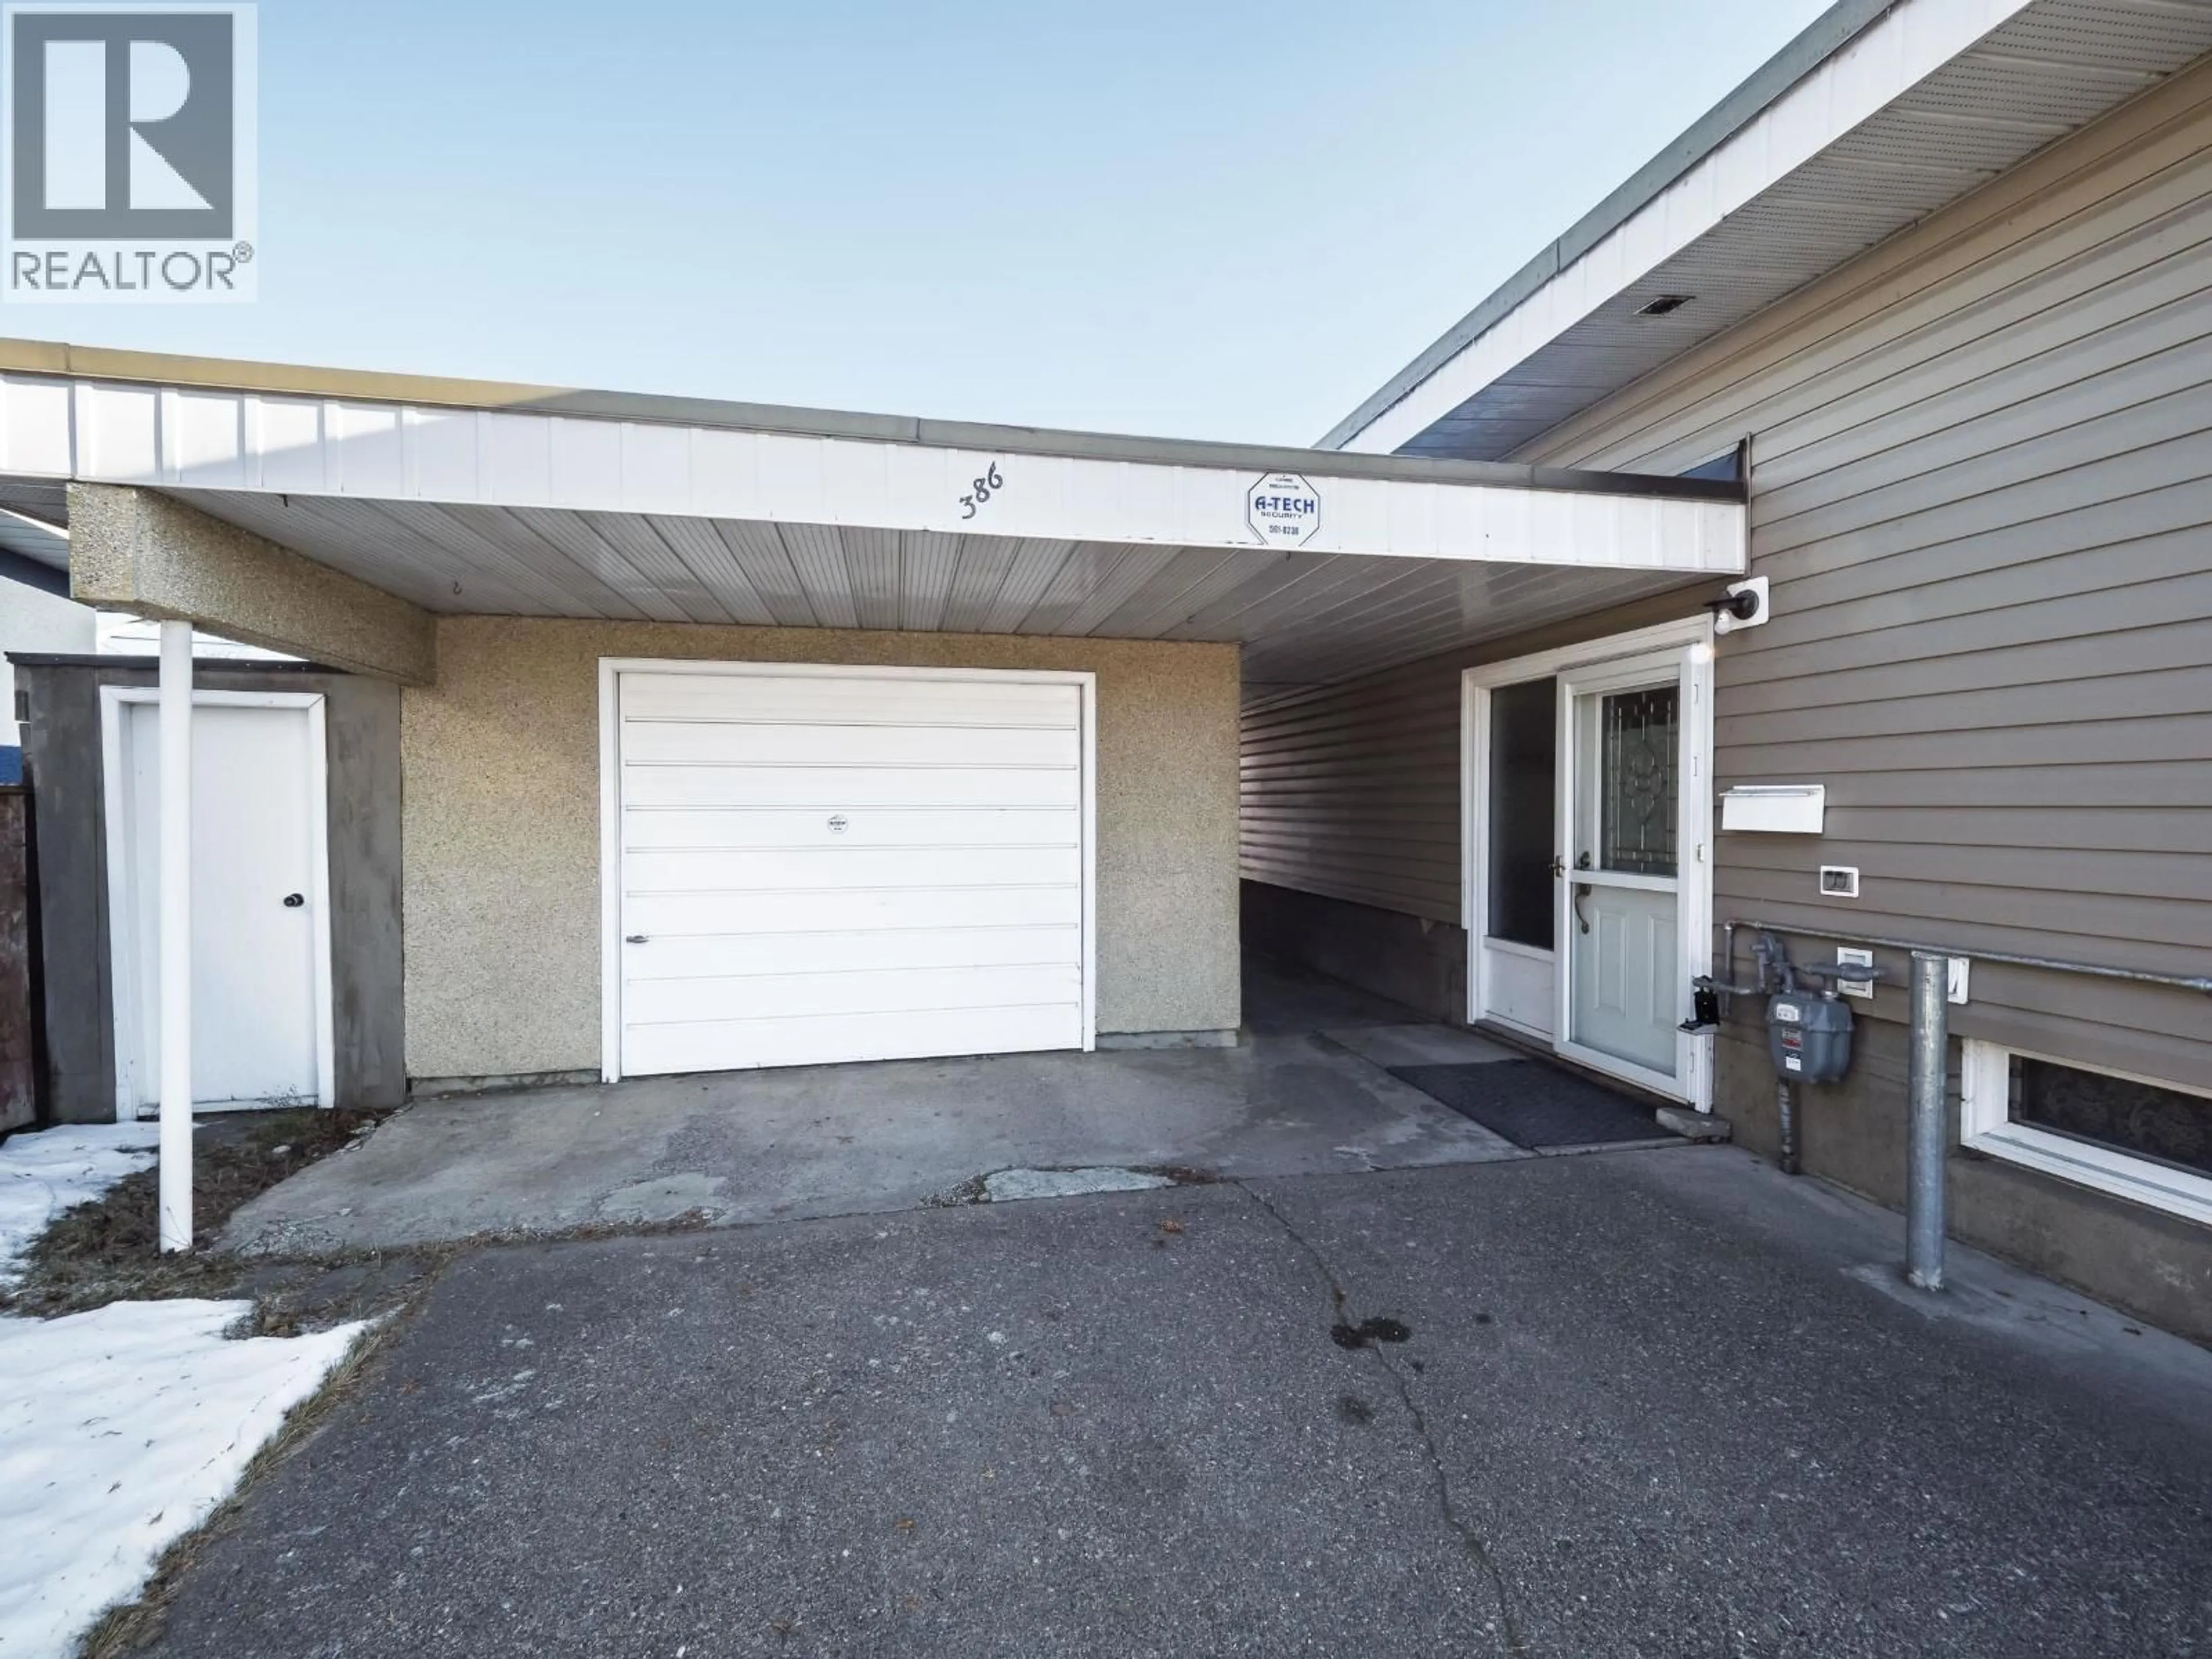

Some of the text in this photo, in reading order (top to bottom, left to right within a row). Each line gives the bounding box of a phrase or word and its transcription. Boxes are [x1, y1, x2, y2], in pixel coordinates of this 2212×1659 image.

[959, 461, 1003, 519] 386
[1255, 496, 1315, 514] A-TECH
[1260, 511, 1302, 519] SECURITY
